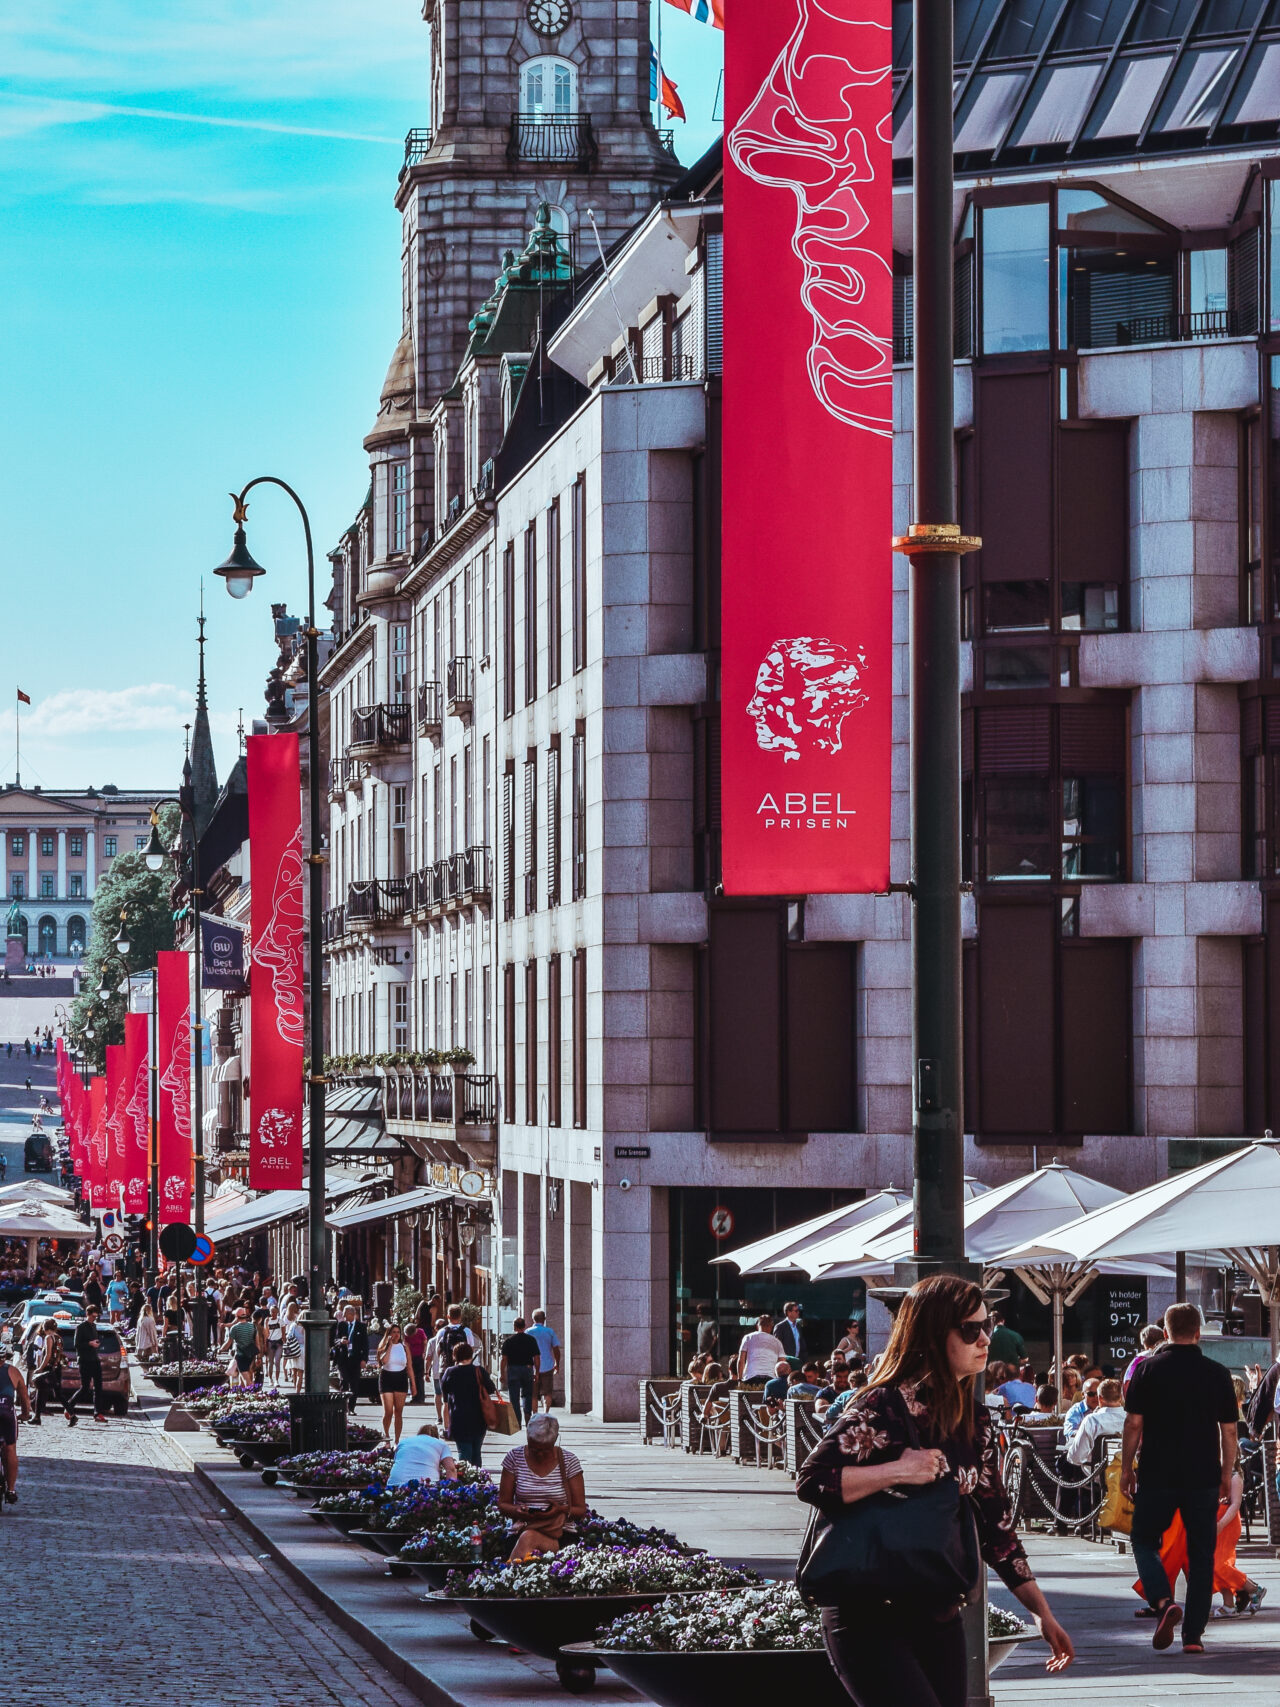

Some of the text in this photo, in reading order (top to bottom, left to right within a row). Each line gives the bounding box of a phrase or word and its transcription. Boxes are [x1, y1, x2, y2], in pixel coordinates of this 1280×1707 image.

[756, 792, 856, 814] ABEL
[765, 818, 847, 829] PRISEN
[213, 942, 230, 952] BW
[213, 958, 232, 968] Best
[205, 966, 240, 976] Western
[260, 1157, 292, 1165] ABEL
[1118, 1291, 1141, 1299] holder
[1110, 1300, 1131, 1309] åpent
[1110, 1313, 1140, 1326] 9-17
[1110, 1336, 1135, 1345] Lørdag
[1110, 1347, 1145, 1358] 10-1
